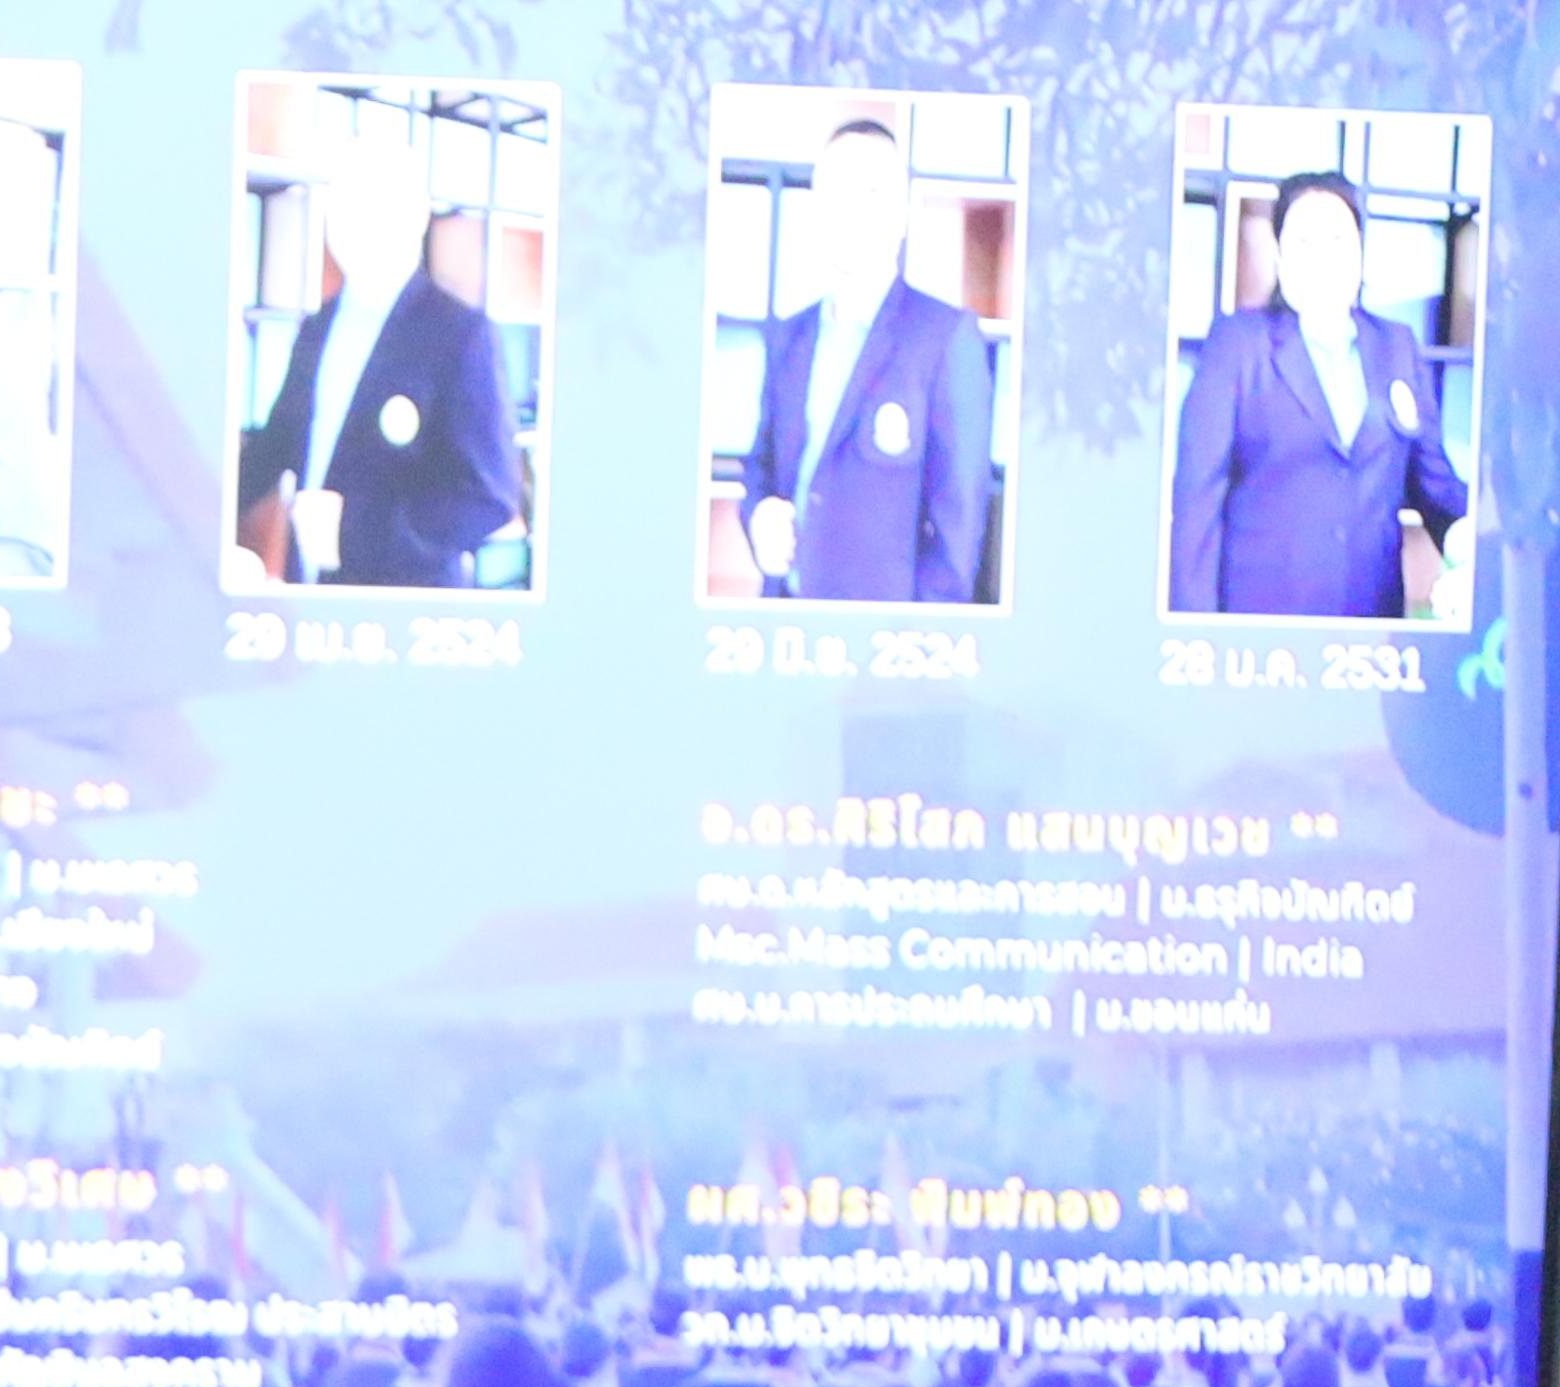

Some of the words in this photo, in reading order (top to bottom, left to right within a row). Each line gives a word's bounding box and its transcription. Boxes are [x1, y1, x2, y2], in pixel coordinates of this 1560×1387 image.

[1320, 643, 1424, 690] 2531
[900, 928, 1228, 975] Communication
[1263, 935, 1363, 978] India
